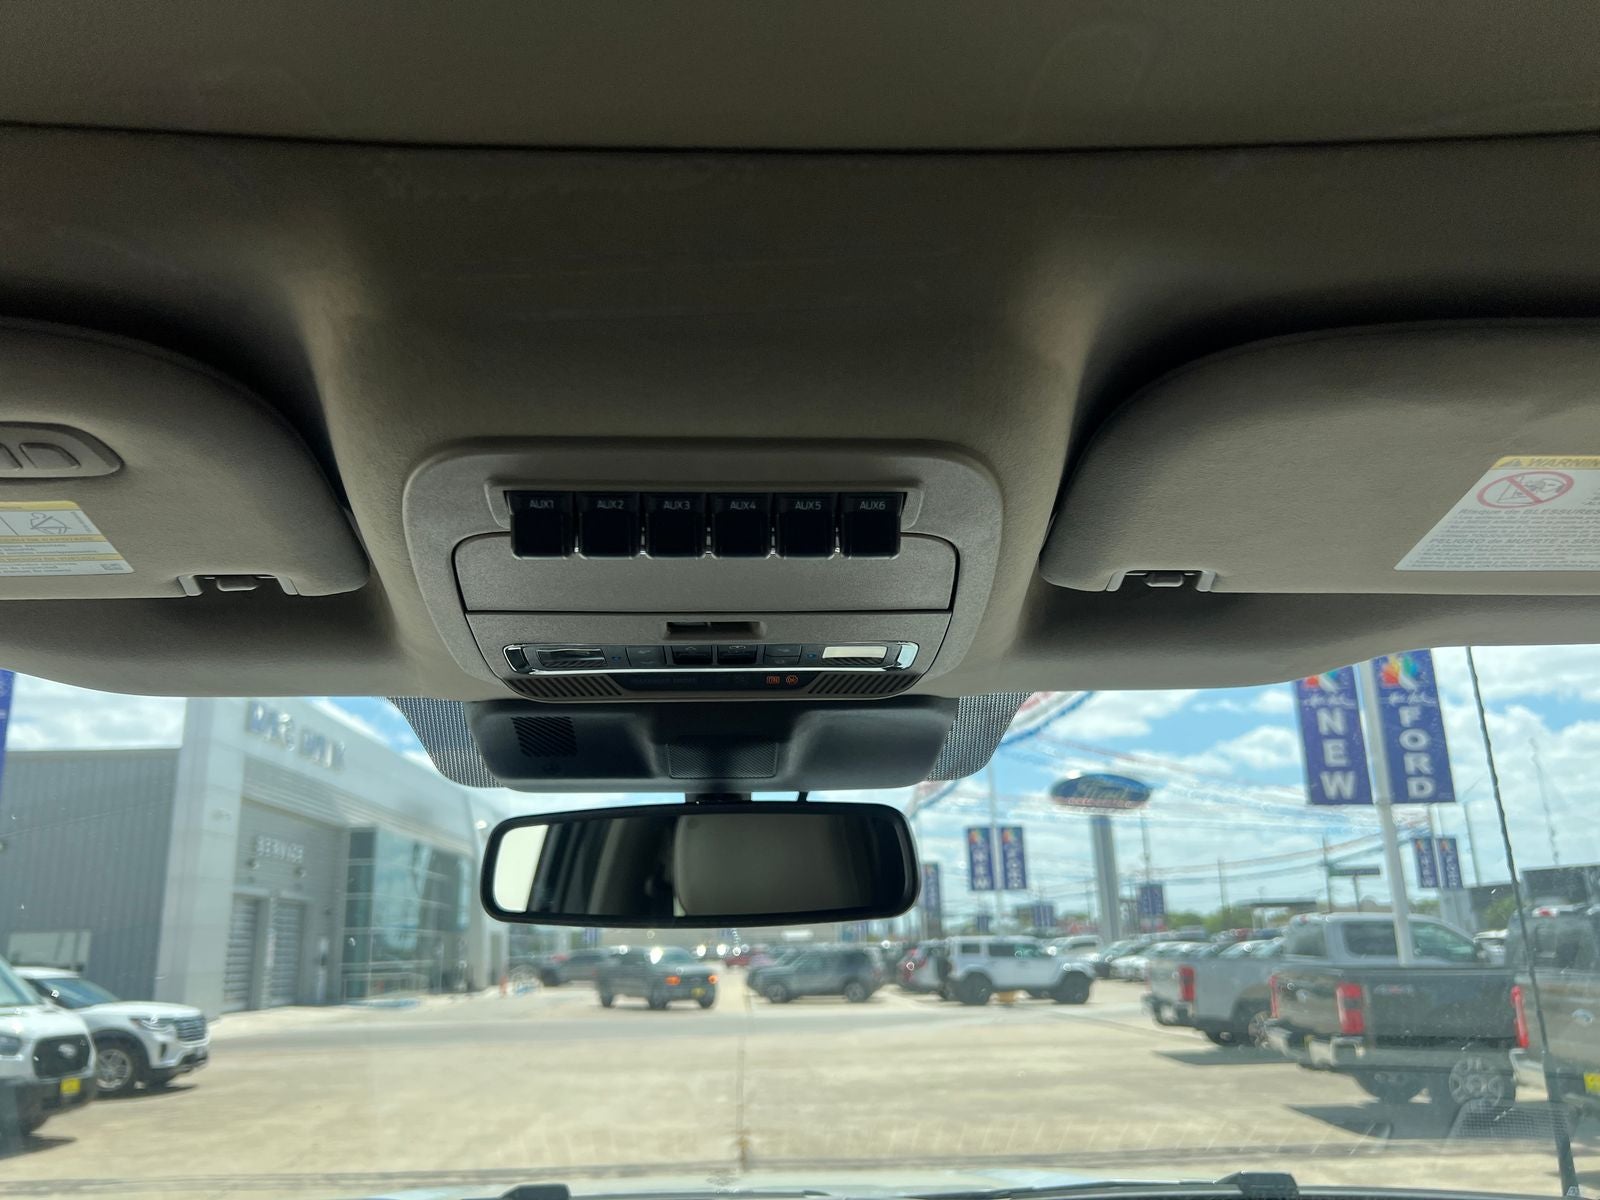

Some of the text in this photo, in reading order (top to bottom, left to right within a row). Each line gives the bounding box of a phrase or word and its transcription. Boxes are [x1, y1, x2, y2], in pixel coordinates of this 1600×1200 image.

[529, 499, 555, 510] AUX1
[596, 499, 625, 510] AUX2
[662, 499, 691, 511] AUX3
[729, 500, 757, 511] AUX4
[794, 500, 822, 511] AUX5
[859, 500, 887, 511] AUX6
[1316, 707, 1358, 800] NEW
[1397, 705, 1437, 799] FORD
